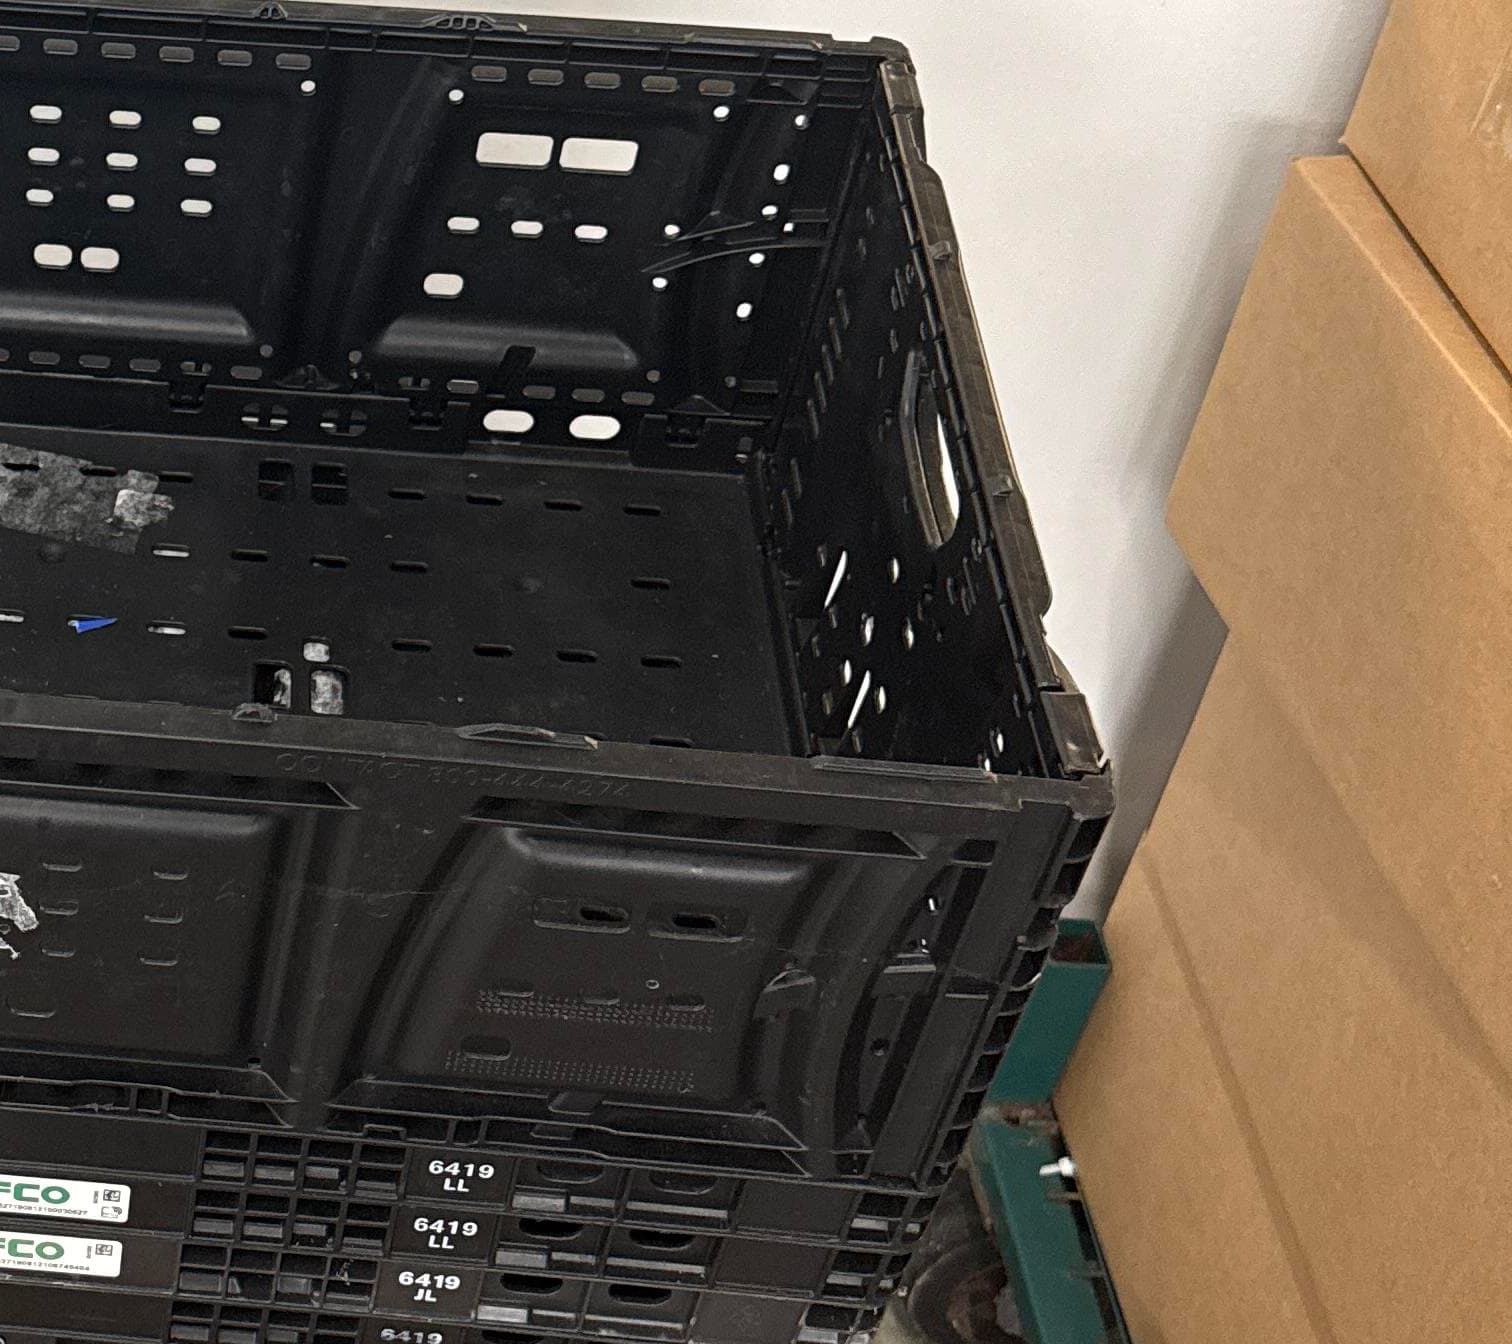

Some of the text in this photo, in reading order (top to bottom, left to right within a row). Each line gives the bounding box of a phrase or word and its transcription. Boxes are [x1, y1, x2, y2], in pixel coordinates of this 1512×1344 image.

[429, 1160, 495, 1179] 6419
[443, 1177, 470, 1192] LL
[413, 1217, 478, 1237] 6419
[428, 1234, 455, 1249] LL
[398, 1271, 461, 1290] 6419
[413, 1288, 437, 1303] JL
